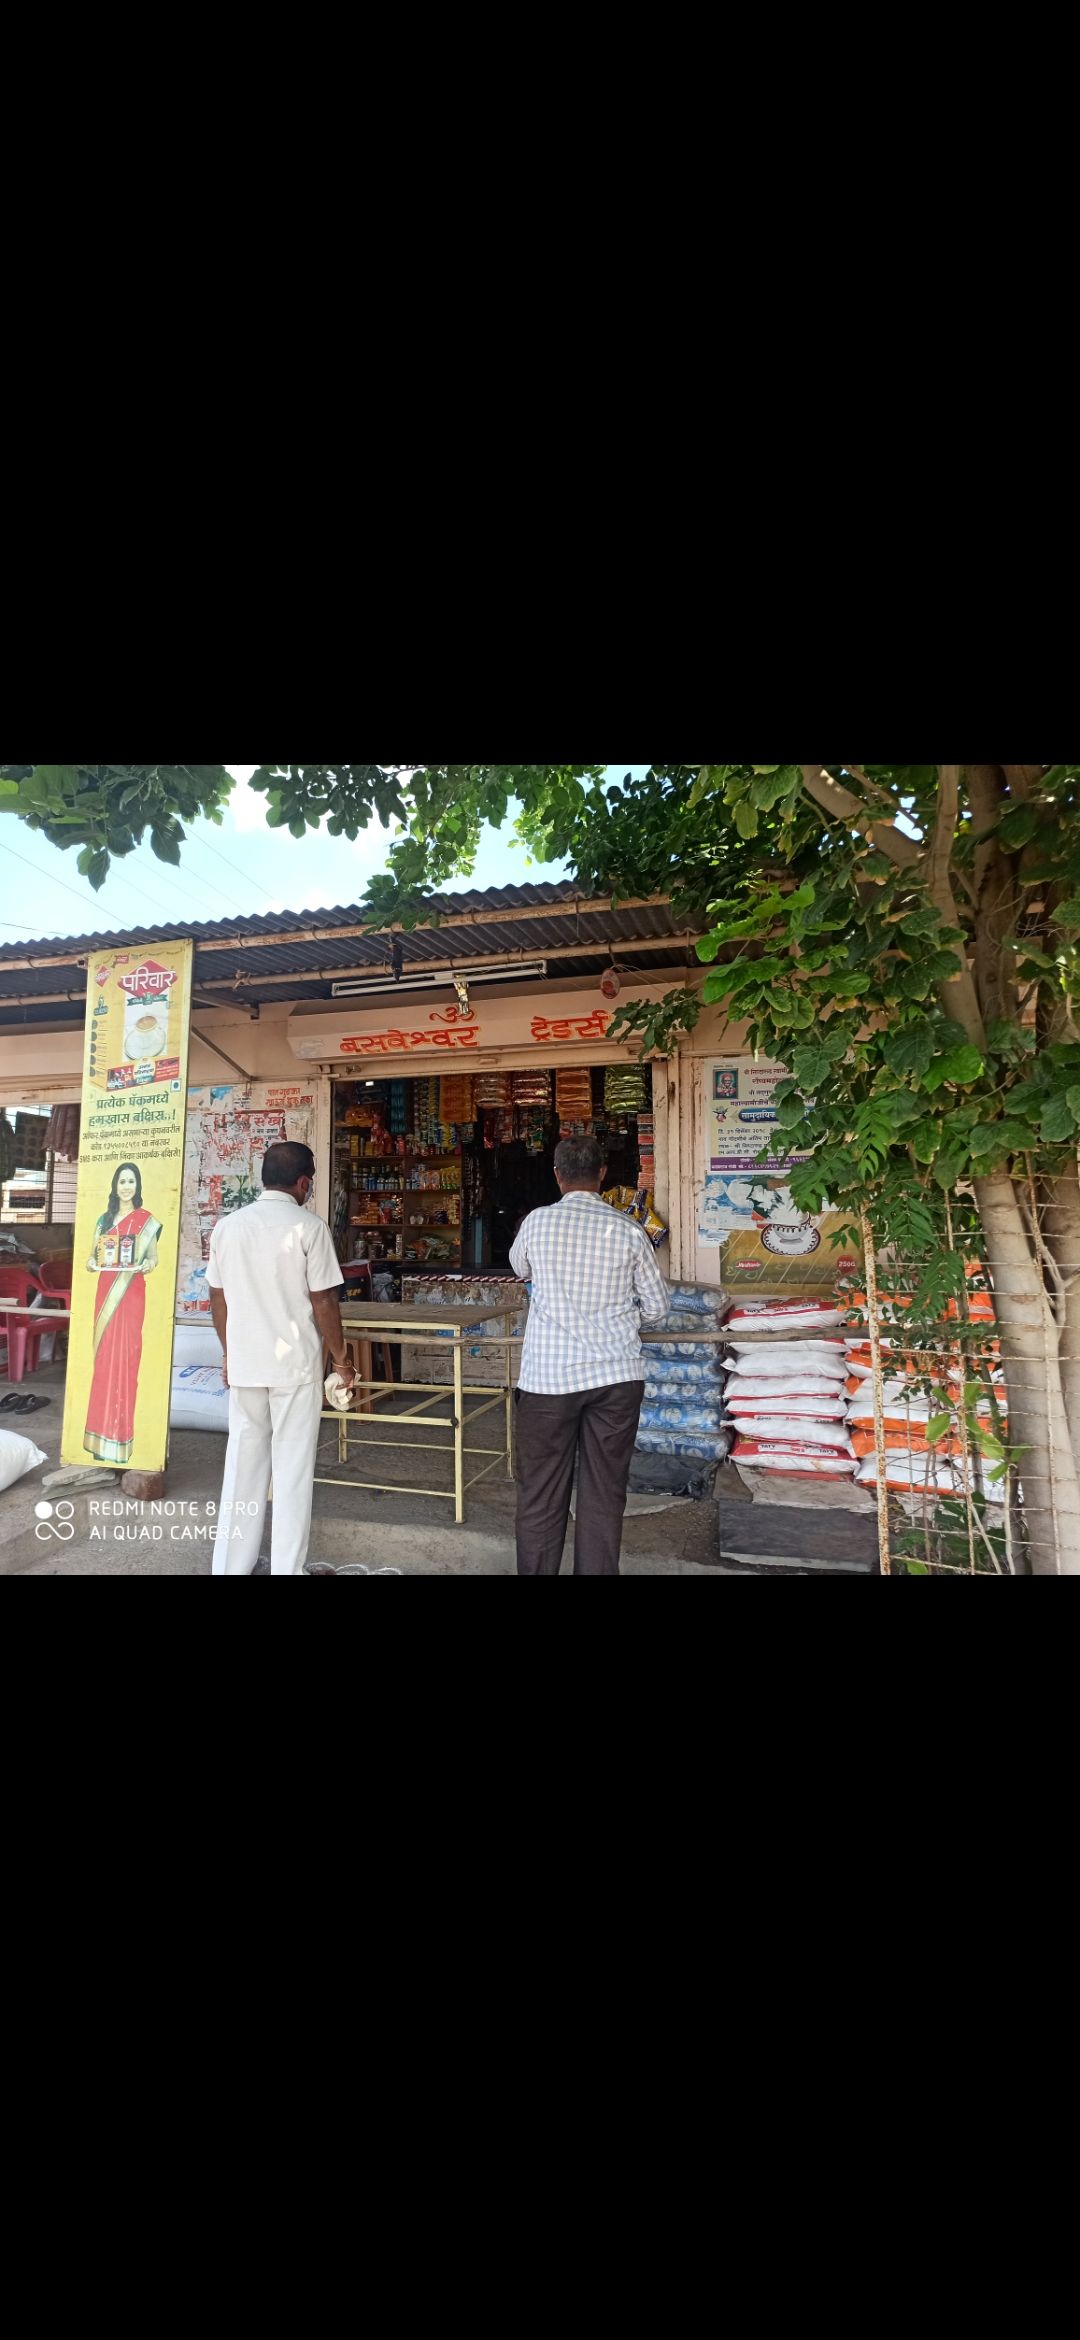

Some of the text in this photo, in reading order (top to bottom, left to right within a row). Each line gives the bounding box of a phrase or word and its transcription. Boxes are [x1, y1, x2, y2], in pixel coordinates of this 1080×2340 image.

[120, 966, 176, 991] परिवार
[340, 1009, 610, 1054] बसवेश्वर ट्रेडर्स
[96, 1095, 126, 1109] प्रत्येक
[88, 1113, 130, 1127] हमखास
